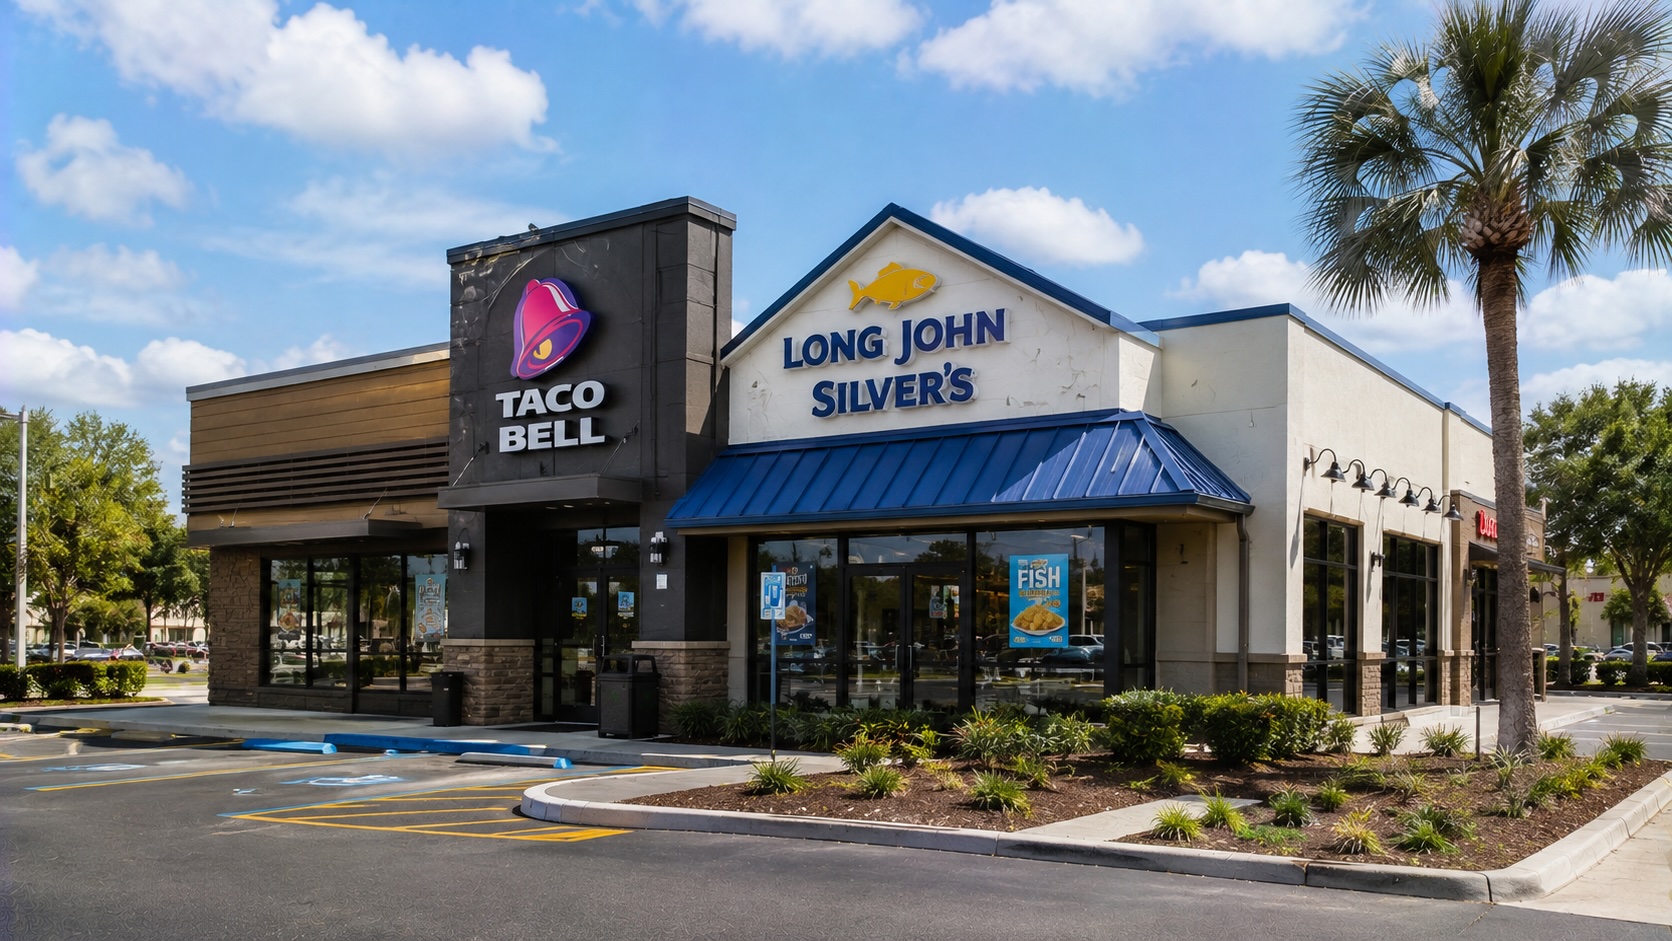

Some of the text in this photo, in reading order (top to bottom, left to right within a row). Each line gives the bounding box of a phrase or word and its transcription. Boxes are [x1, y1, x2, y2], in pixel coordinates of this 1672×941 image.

[783, 308, 1009, 370] LONG JOHN
[495, 380, 605, 419] TACO
[811, 361, 976, 418] SILVER'S
[499, 416, 606, 453] BELL
[1018, 566, 1060, 589] FISH
